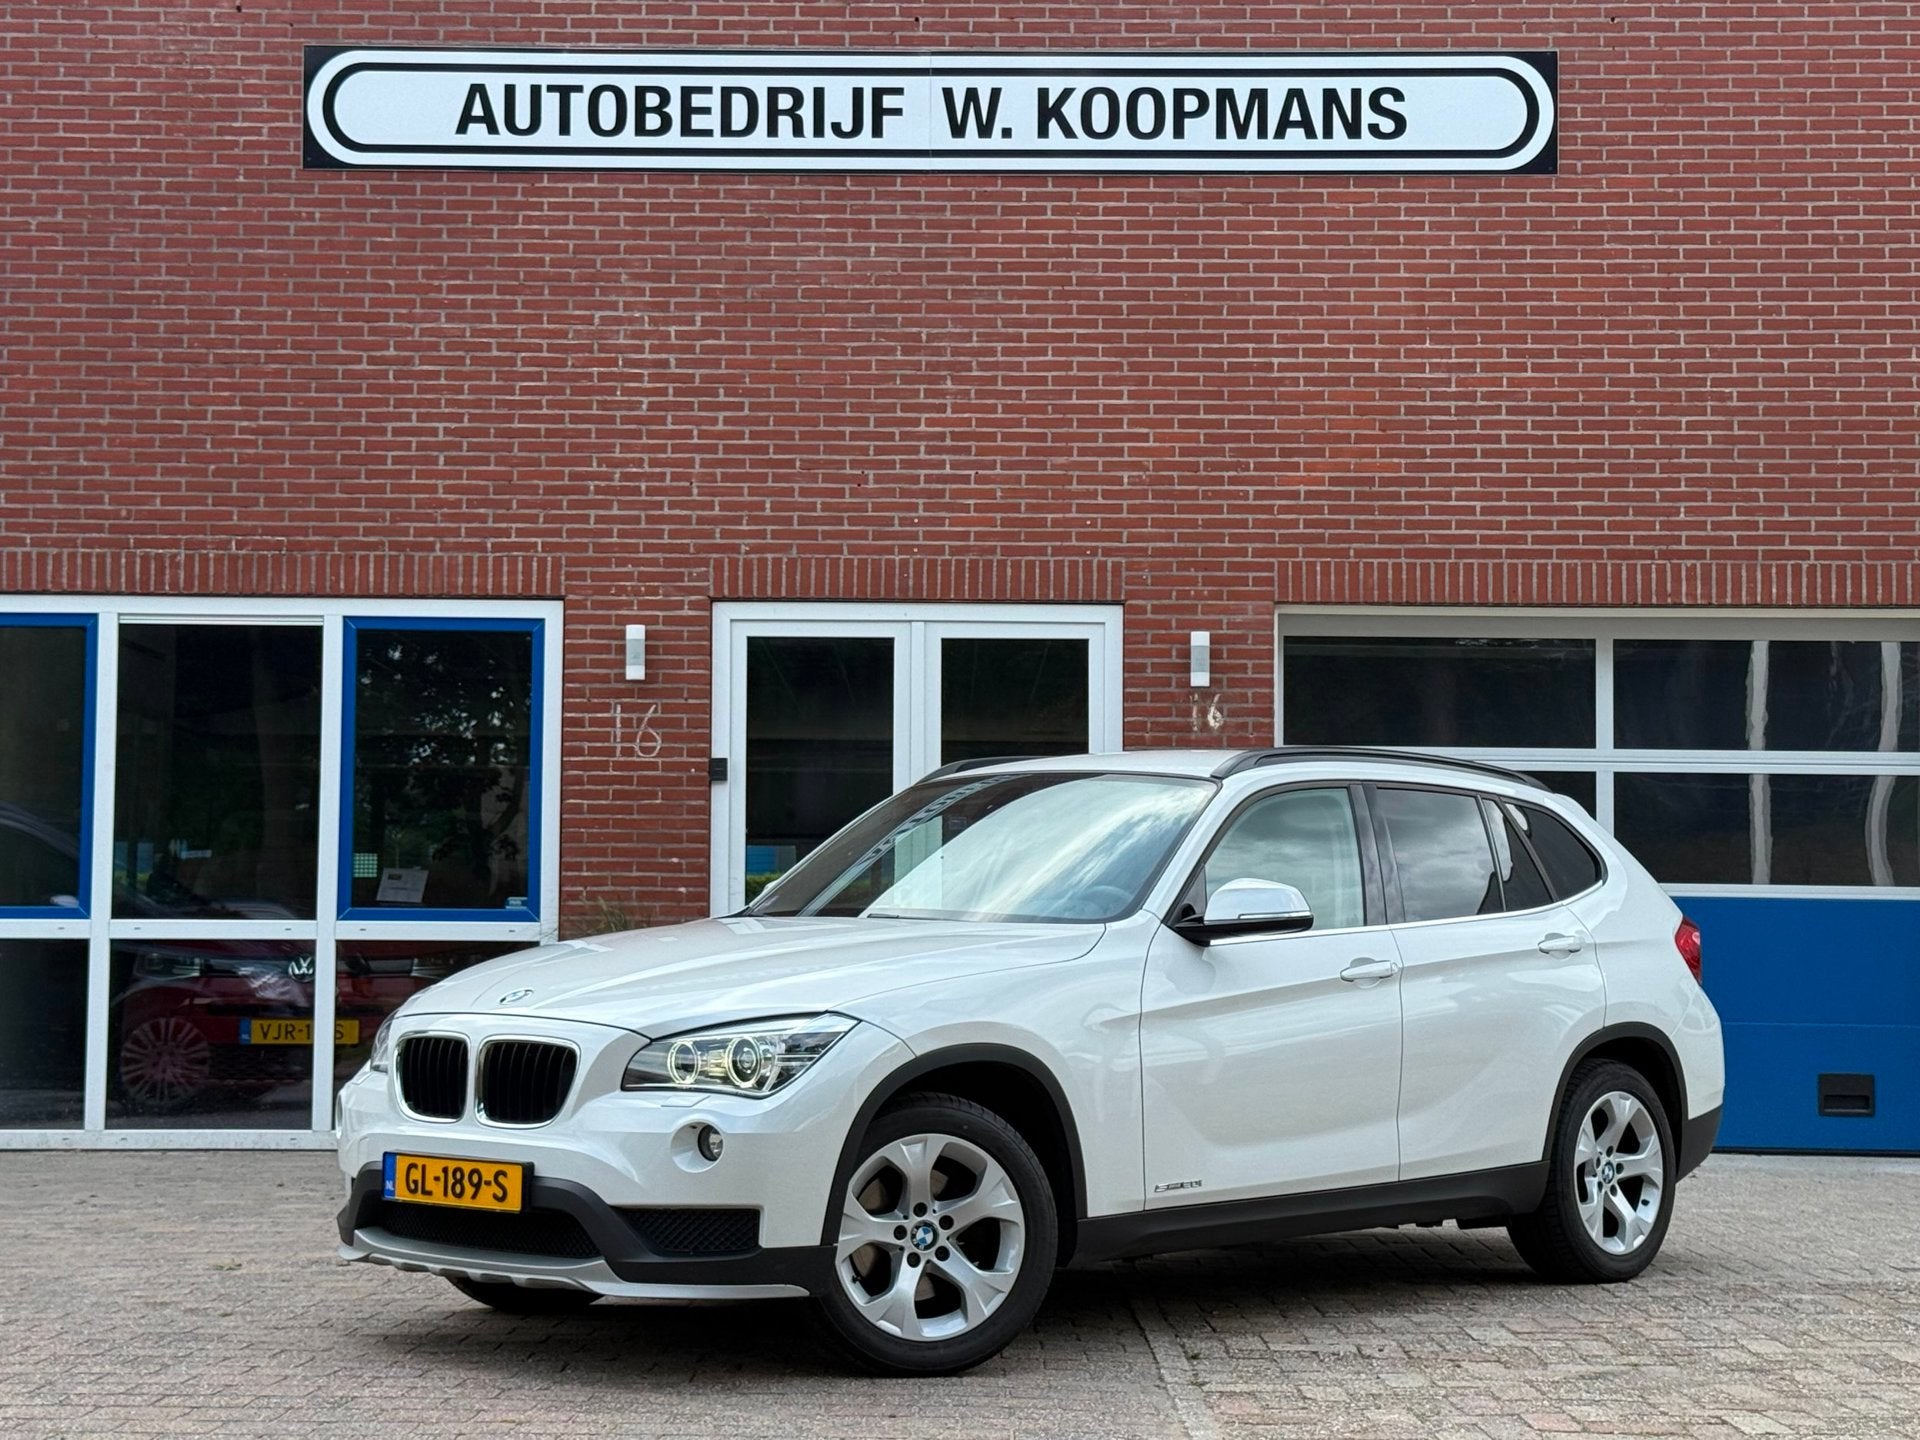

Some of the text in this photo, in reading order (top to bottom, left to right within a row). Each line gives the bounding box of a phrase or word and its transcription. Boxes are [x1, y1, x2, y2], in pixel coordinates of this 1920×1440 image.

[456, 84, 1407, 140] AUTOBEDRIJF W. KOOPMANS
[615, 704, 662, 757] 16
[1189, 693, 1224, 731] 16
[405, 1162, 508, 1203] GL-189-S
